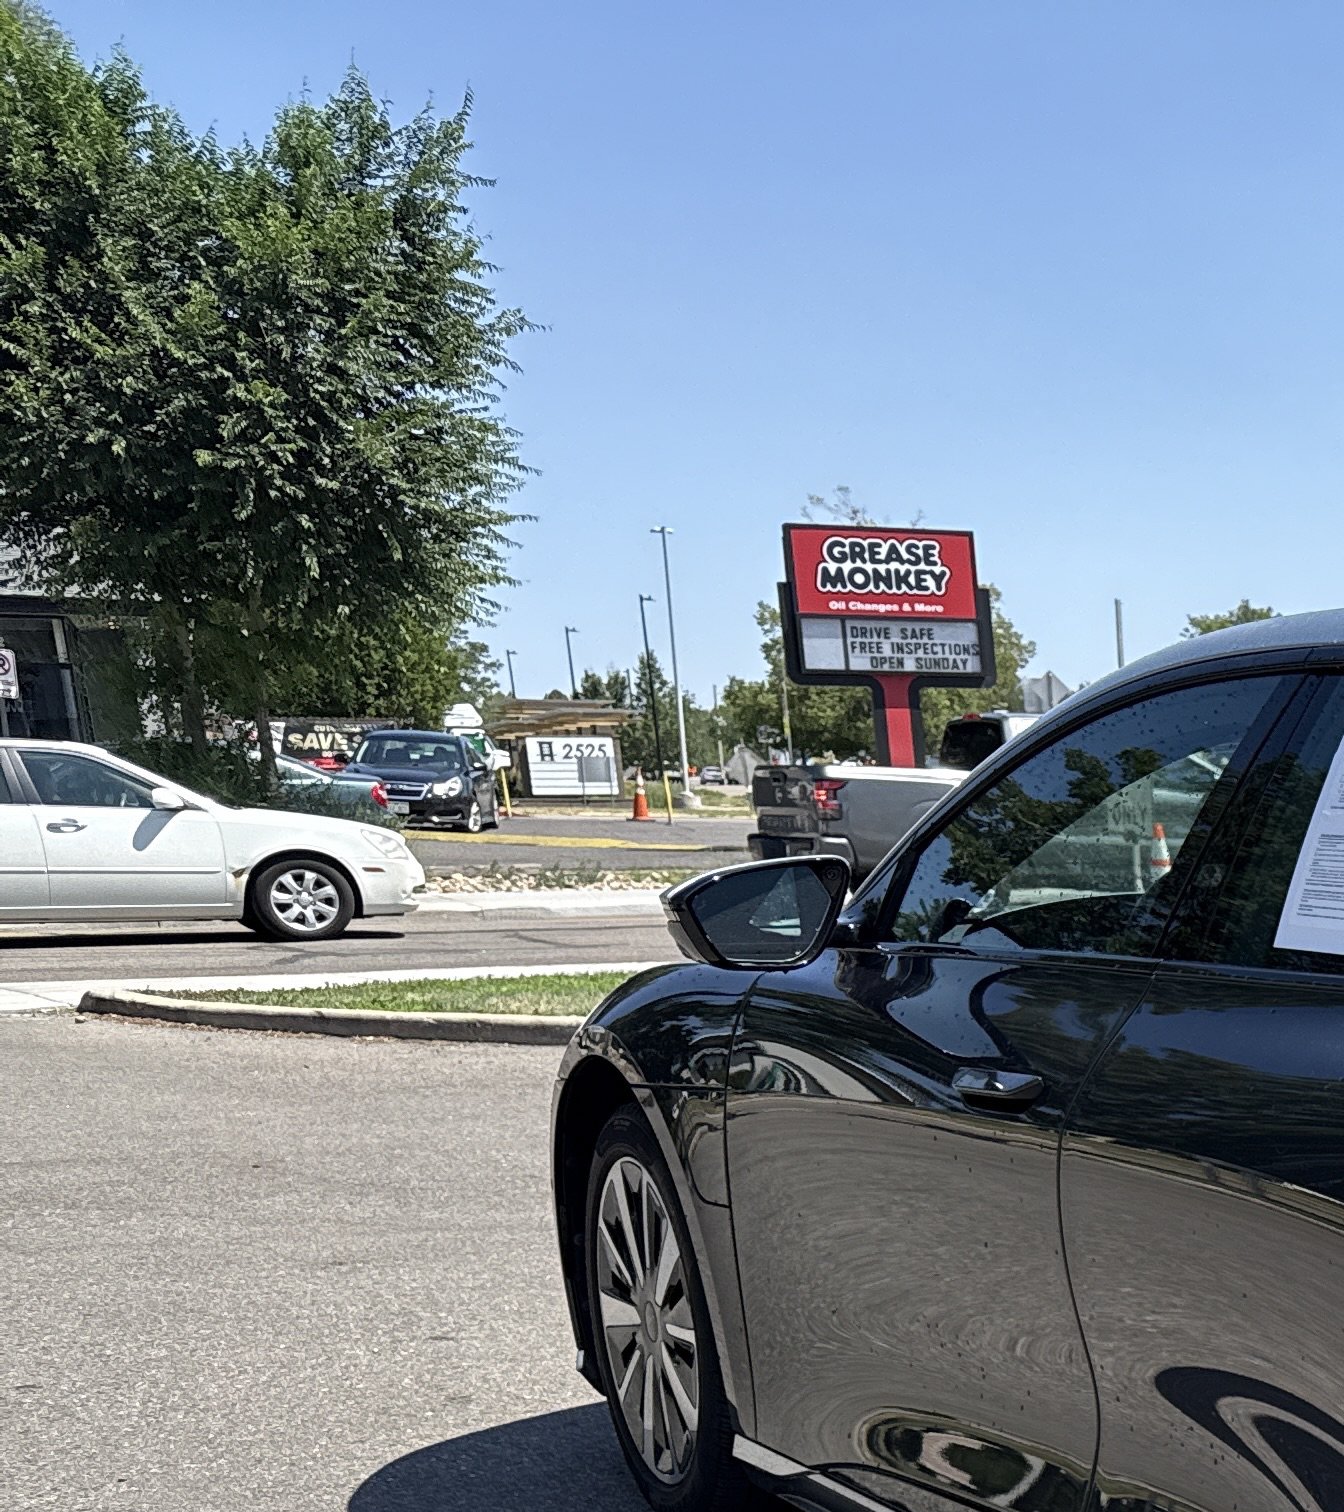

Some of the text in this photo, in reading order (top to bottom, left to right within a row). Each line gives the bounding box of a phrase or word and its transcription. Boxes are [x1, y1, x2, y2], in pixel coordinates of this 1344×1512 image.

[824, 539, 938, 567] GREASE
[819, 566, 948, 592] MONKEY
[828, 601, 944, 613] Oil Changes & More
[850, 626, 935, 641] DRIVE SAFE
[850, 641, 980, 656] FREE INSPECTIONS
[870, 657, 969, 671] OPEN SUNDAY
[287, 732, 348, 751] SAVE
[562, 743, 607, 760] 2525
